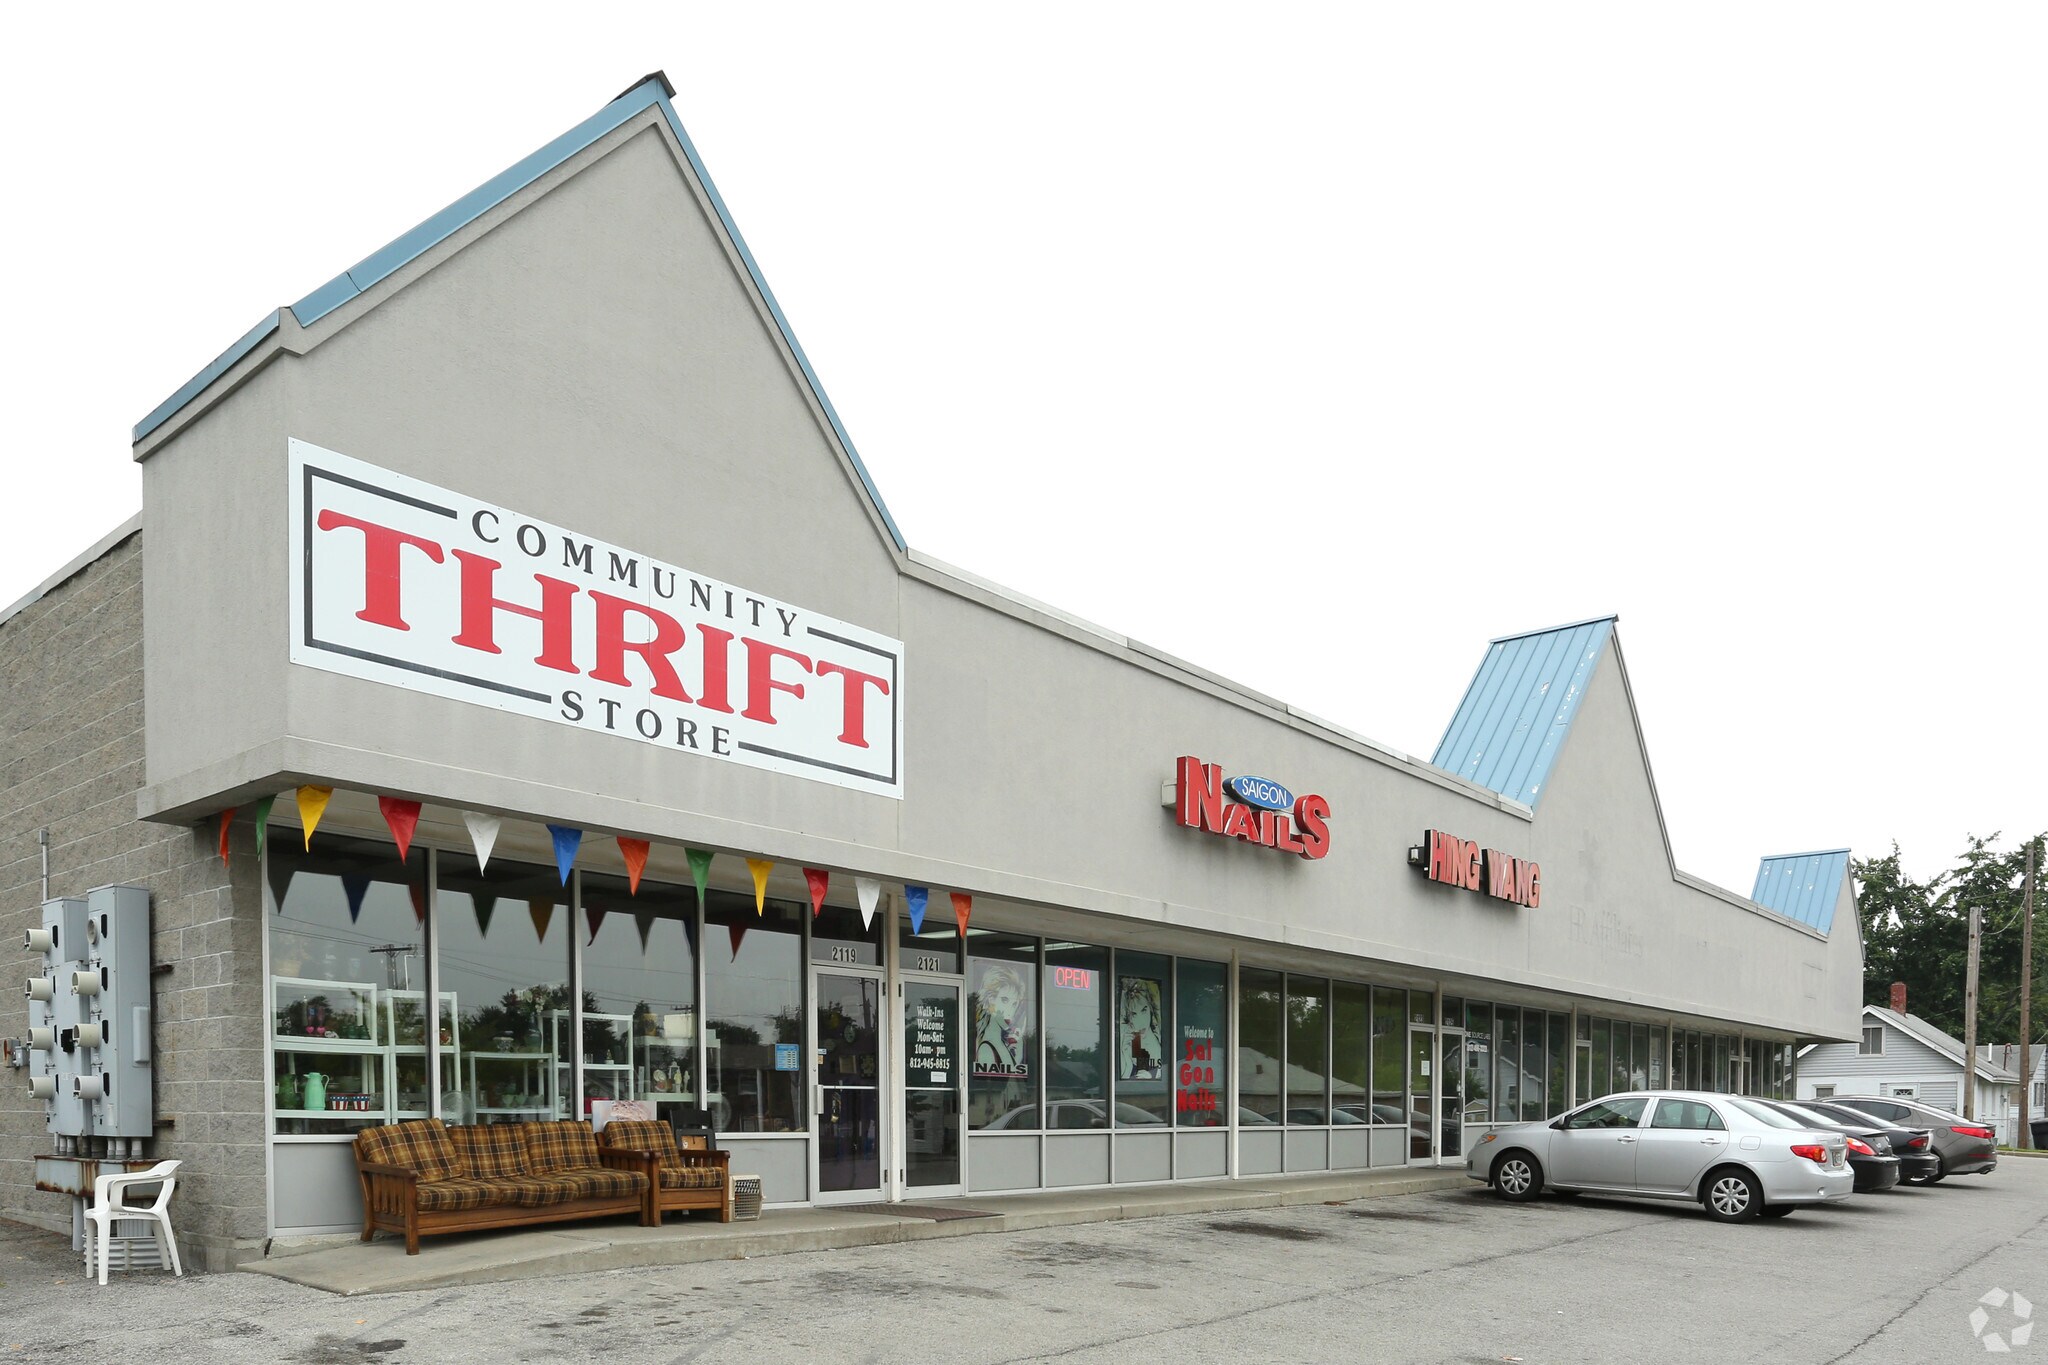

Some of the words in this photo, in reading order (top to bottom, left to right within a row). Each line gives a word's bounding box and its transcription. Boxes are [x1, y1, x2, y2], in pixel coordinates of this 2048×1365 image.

[472, 510, 798, 636] COMMUNITY
[317, 509, 890, 749] THRIFT
[561, 690, 731, 757] STORE
[1241, 777, 1288, 807] SAIGON
[1176, 755, 1332, 861] NAILS
[1425, 829, 1480, 892] HING
[1483, 848, 1541, 908] WANG
[832, 946, 857, 963] 2119
[917, 956, 940, 972] 2121
[1055, 967, 1090, 989] OPEN
[916, 1005, 945, 1018] Walk-Ins
[917, 1018, 945, 1031] Welcome
[1184, 1025, 1208, 1039] Welcome
[1208, 1027, 1215, 1039] to
[916, 1031, 945, 1043] Mon-Sat:
[975, 1062, 1027, 1075] NAILS
[1180, 1063, 1214, 1086] Gon
[1177, 1087, 1217, 1112] Nails
